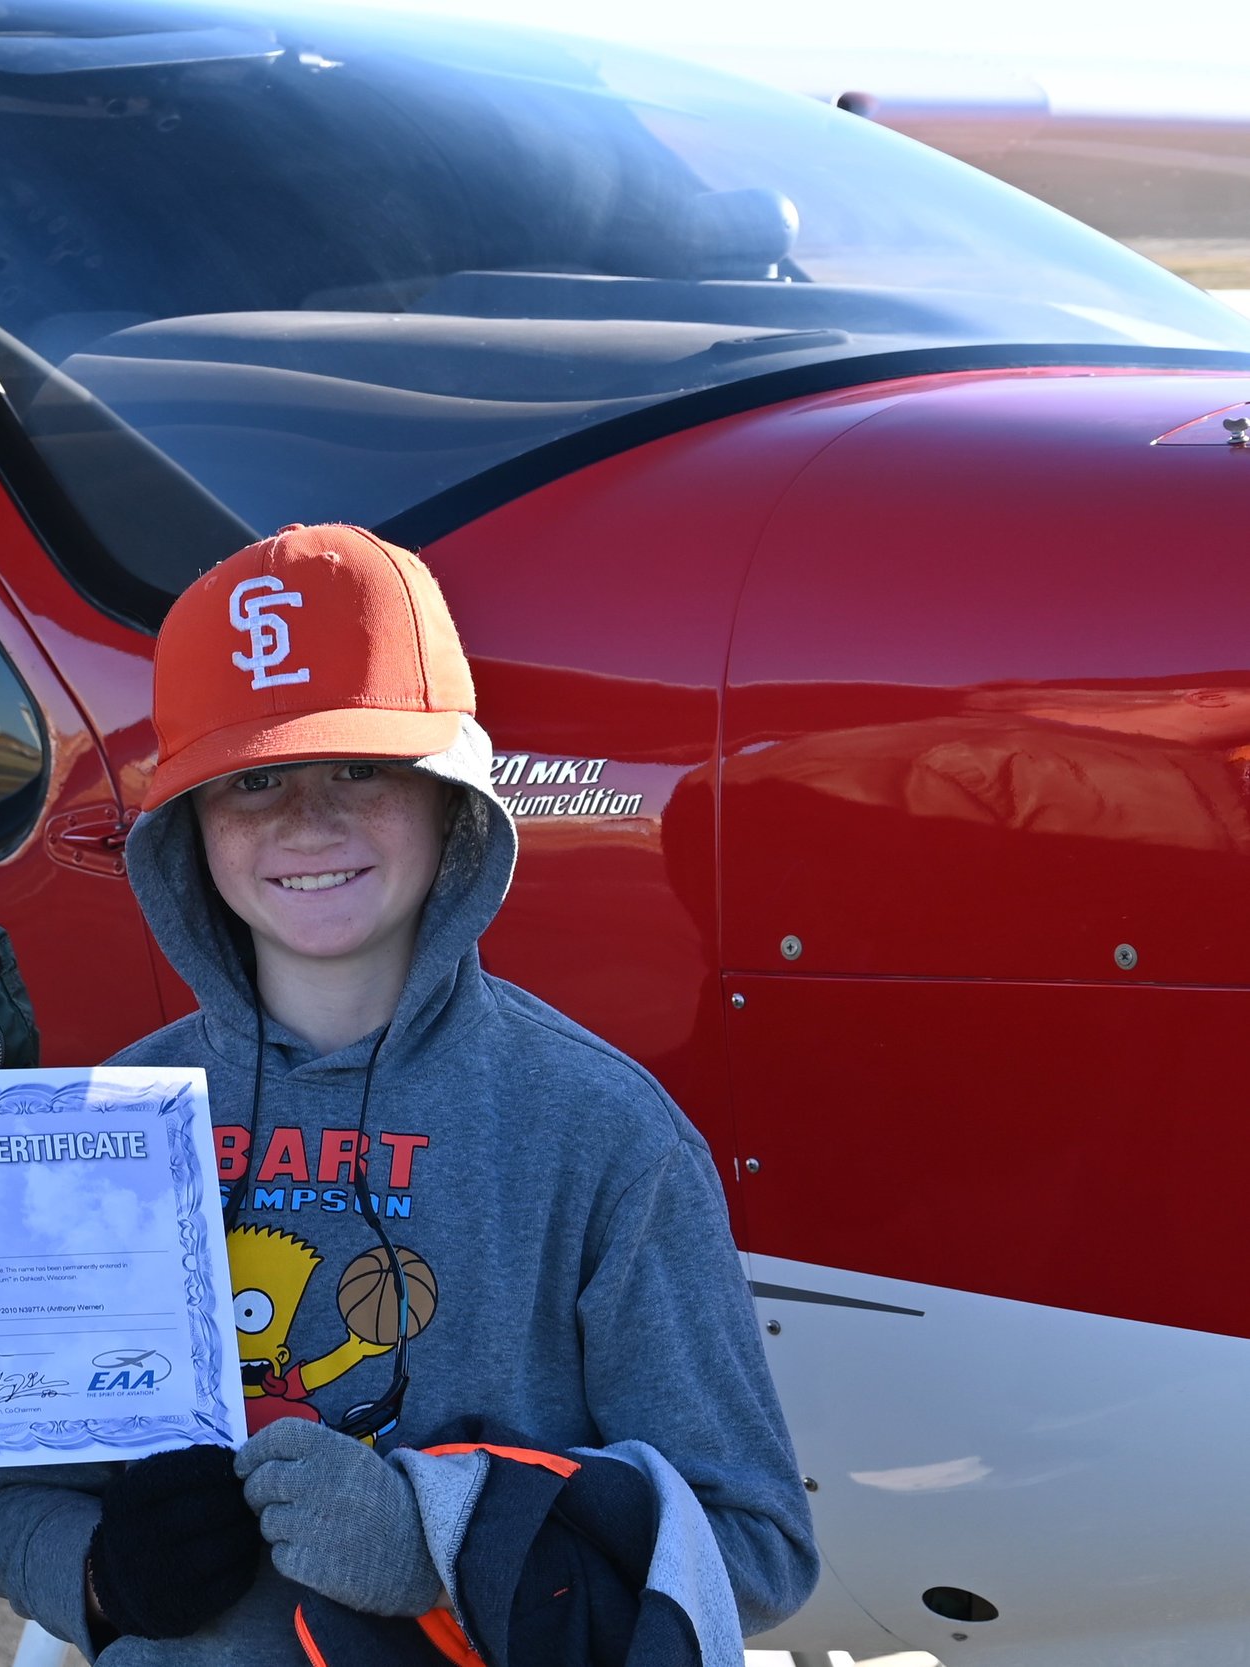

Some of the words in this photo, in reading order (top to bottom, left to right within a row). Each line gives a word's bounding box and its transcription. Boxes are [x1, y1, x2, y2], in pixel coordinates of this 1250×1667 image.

[211, 1124, 430, 1189] BART
[220, 1185, 412, 1218] SMPSON
[63, 1263, 98, 1271] permanently
[47, 1305, 76, 1313] (Anthony
[88, 1370, 155, 1391] EAA
